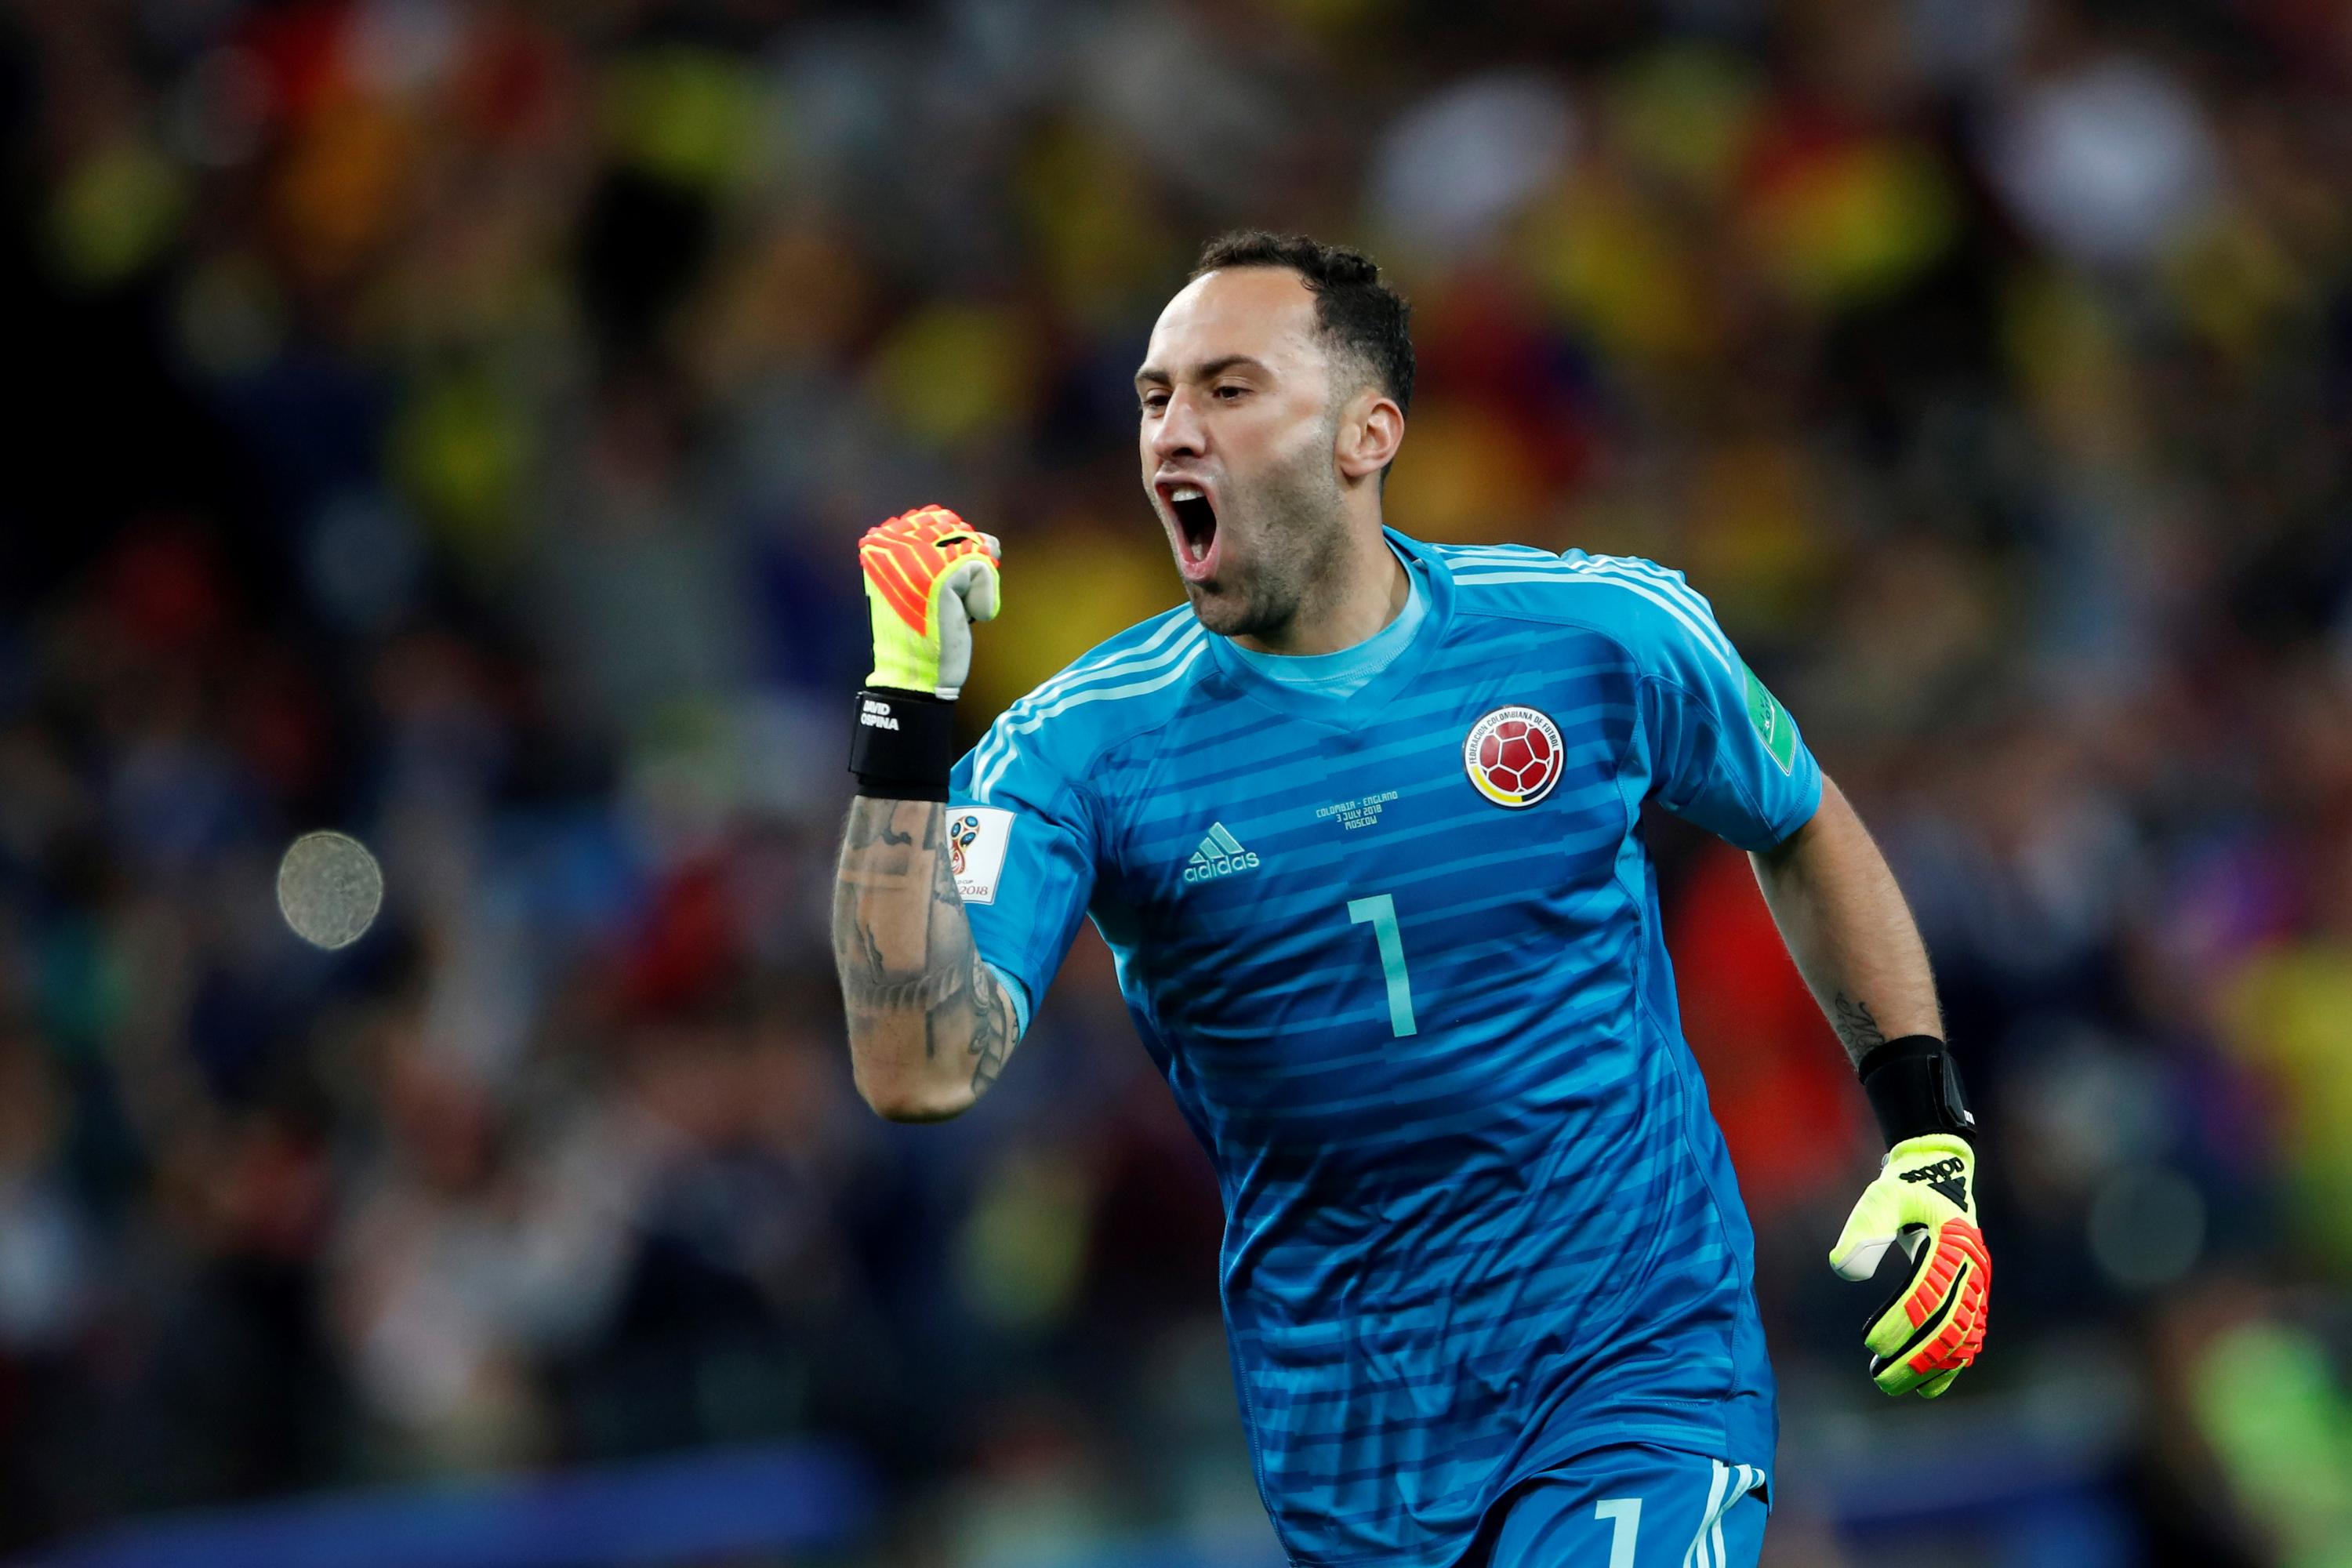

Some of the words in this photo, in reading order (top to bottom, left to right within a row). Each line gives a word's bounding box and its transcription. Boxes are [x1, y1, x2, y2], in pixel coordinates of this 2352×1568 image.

[861, 713, 899, 731] OSPINA
[1486, 711, 1533, 727] COLOMBIANA
[1534, 716, 1543, 725] DE
[1316, 800, 1356, 818] COLOMBIA
[1363, 791, 1398, 807] ENGLAND
[1336, 814, 1342, 822] 3
[1343, 809, 1362, 821] JULY
[1363, 804, 1382, 816] 2018
[1345, 815, 1377, 830] MOSCOW
[1185, 852, 1260, 881] adidas
[959, 886, 988, 895] 2018
[1347, 893, 1417, 1038] 1
[1899, 1156, 1965, 1183] adidas
[1595, 1498, 1642, 1568] 1
